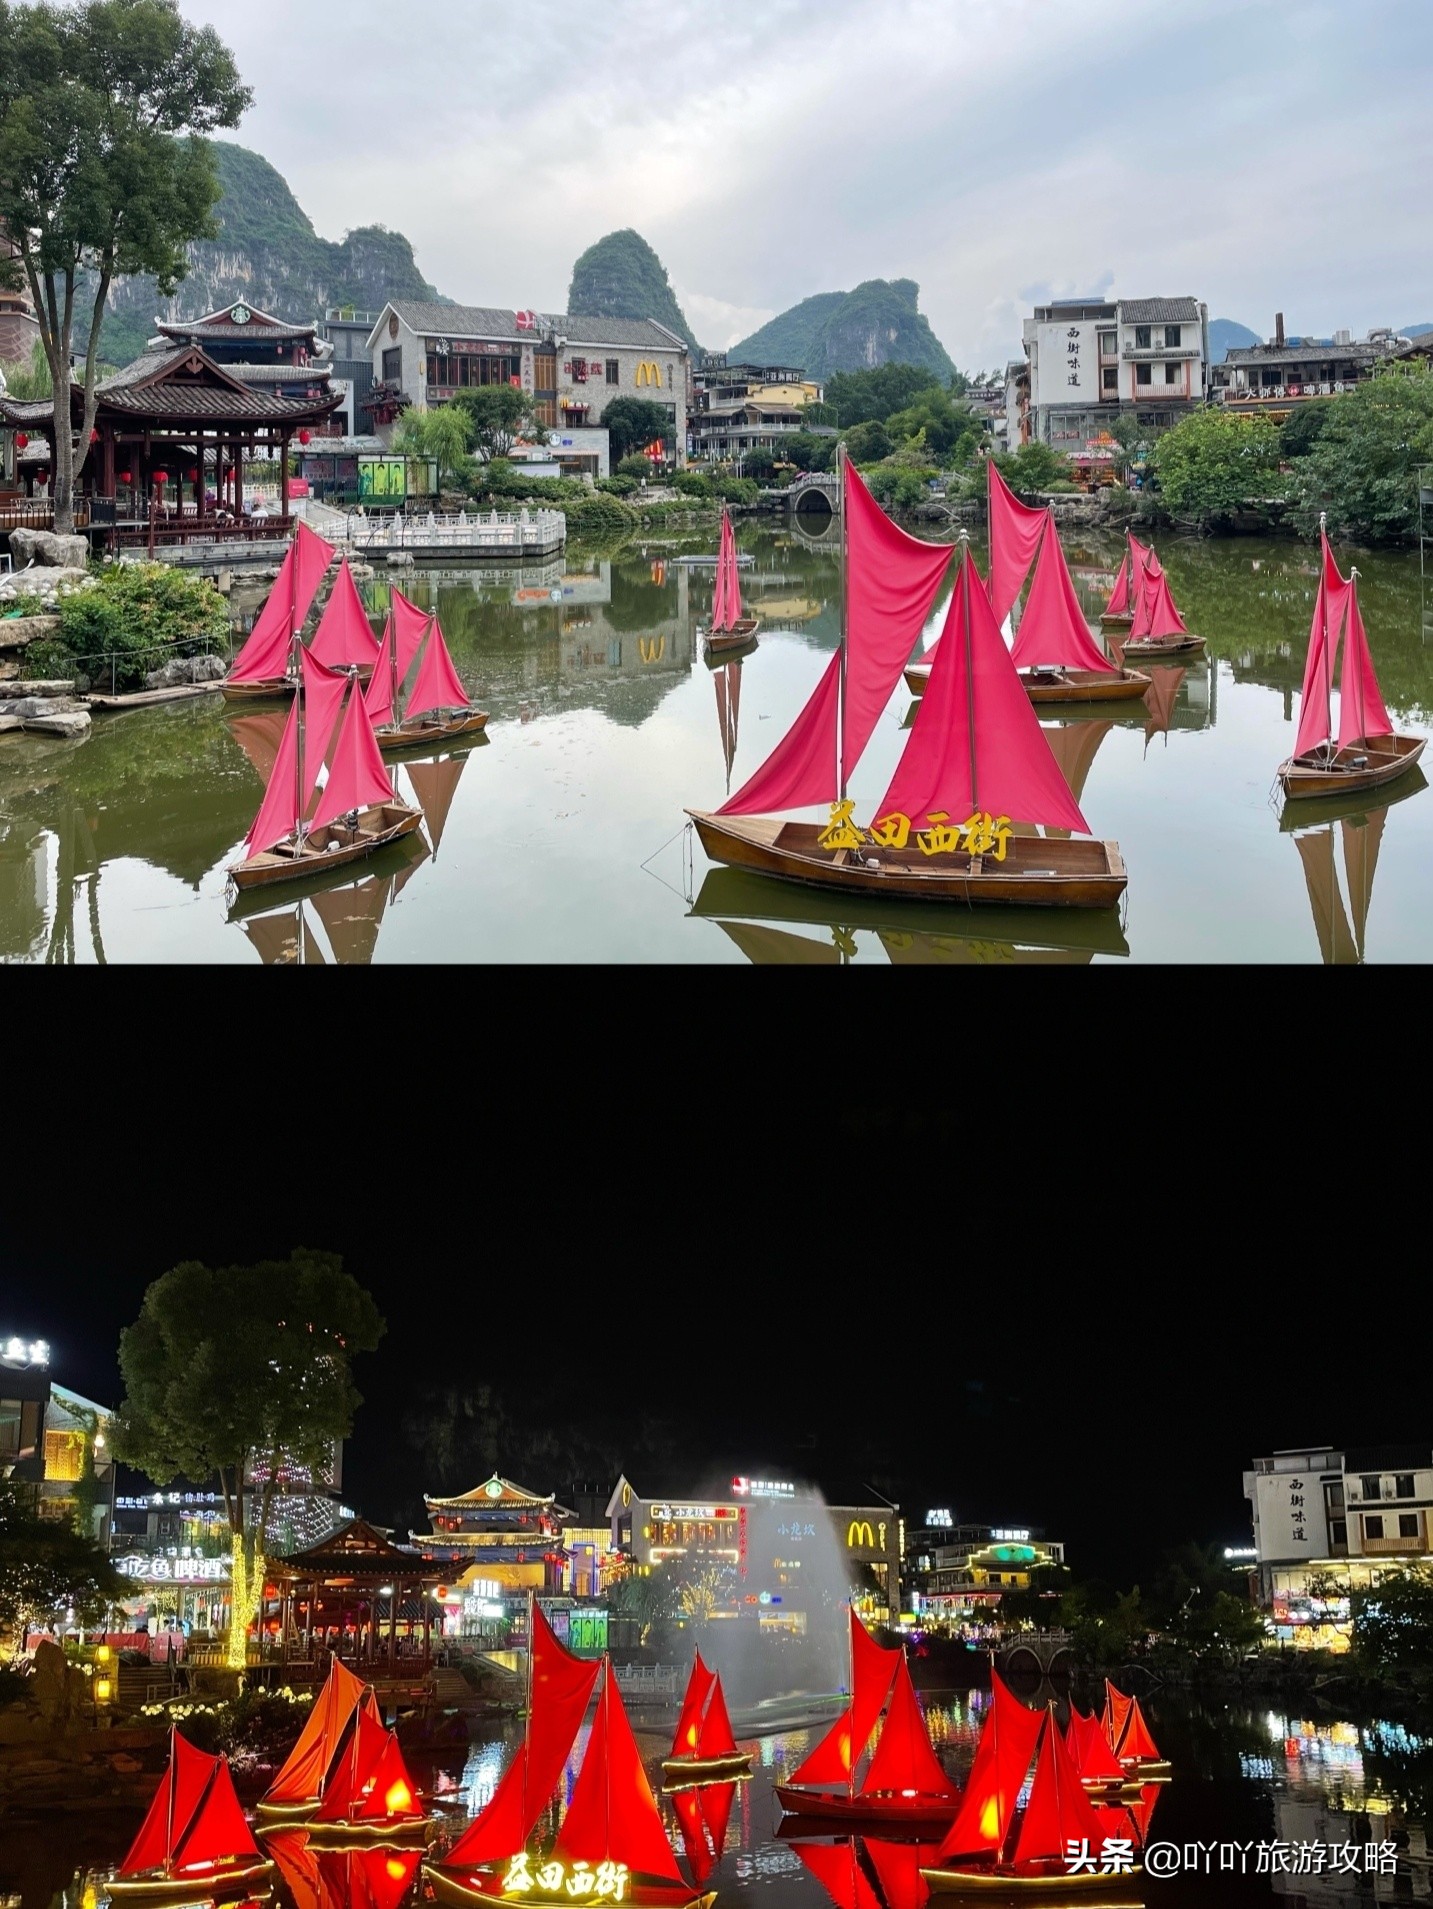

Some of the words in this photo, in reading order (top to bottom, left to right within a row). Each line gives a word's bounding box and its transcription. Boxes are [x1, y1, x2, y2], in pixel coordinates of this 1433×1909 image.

[1067, 327, 1081, 386] 西街味道
[817, 799, 1014, 861] 益田西街
[777, 1522, 816, 1536] 小龙坎
[1289, 1479, 1308, 1542] 西街味道
[502, 1852, 629, 1901] 益田西街
